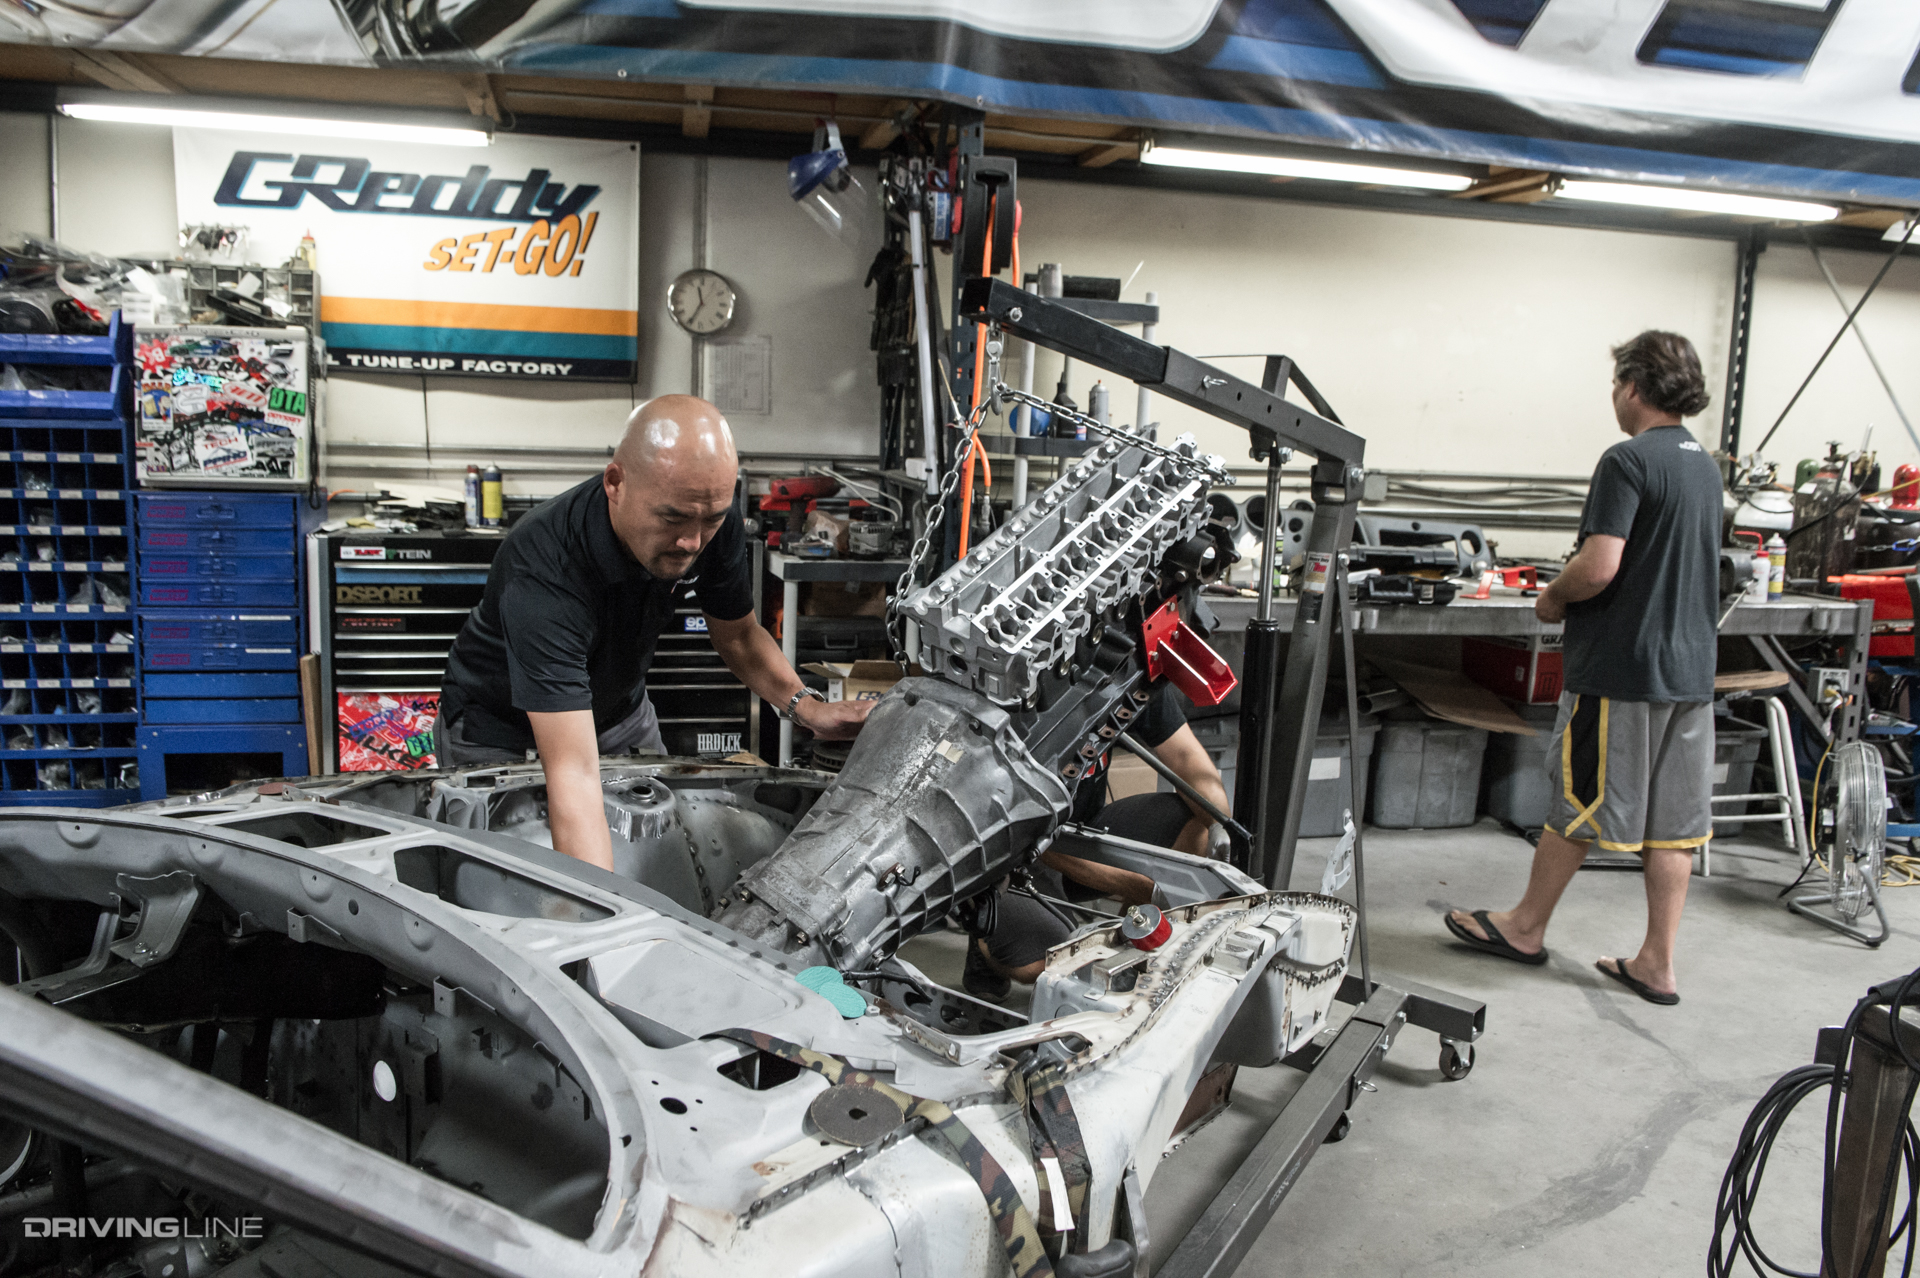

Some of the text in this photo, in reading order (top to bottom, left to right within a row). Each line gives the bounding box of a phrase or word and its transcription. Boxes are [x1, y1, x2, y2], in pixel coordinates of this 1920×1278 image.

[213, 151, 601, 223] GReddy
[423, 211, 599, 277] SET-GO!
[347, 354, 455, 371] TUNE-UP
[462, 359, 573, 376] FACTORY
[269, 387, 306, 415] DTA
[397, 549, 432, 560] TEIN
[336, 586, 422, 604] DSPORT
[697, 733, 742, 753] HRDLCK
